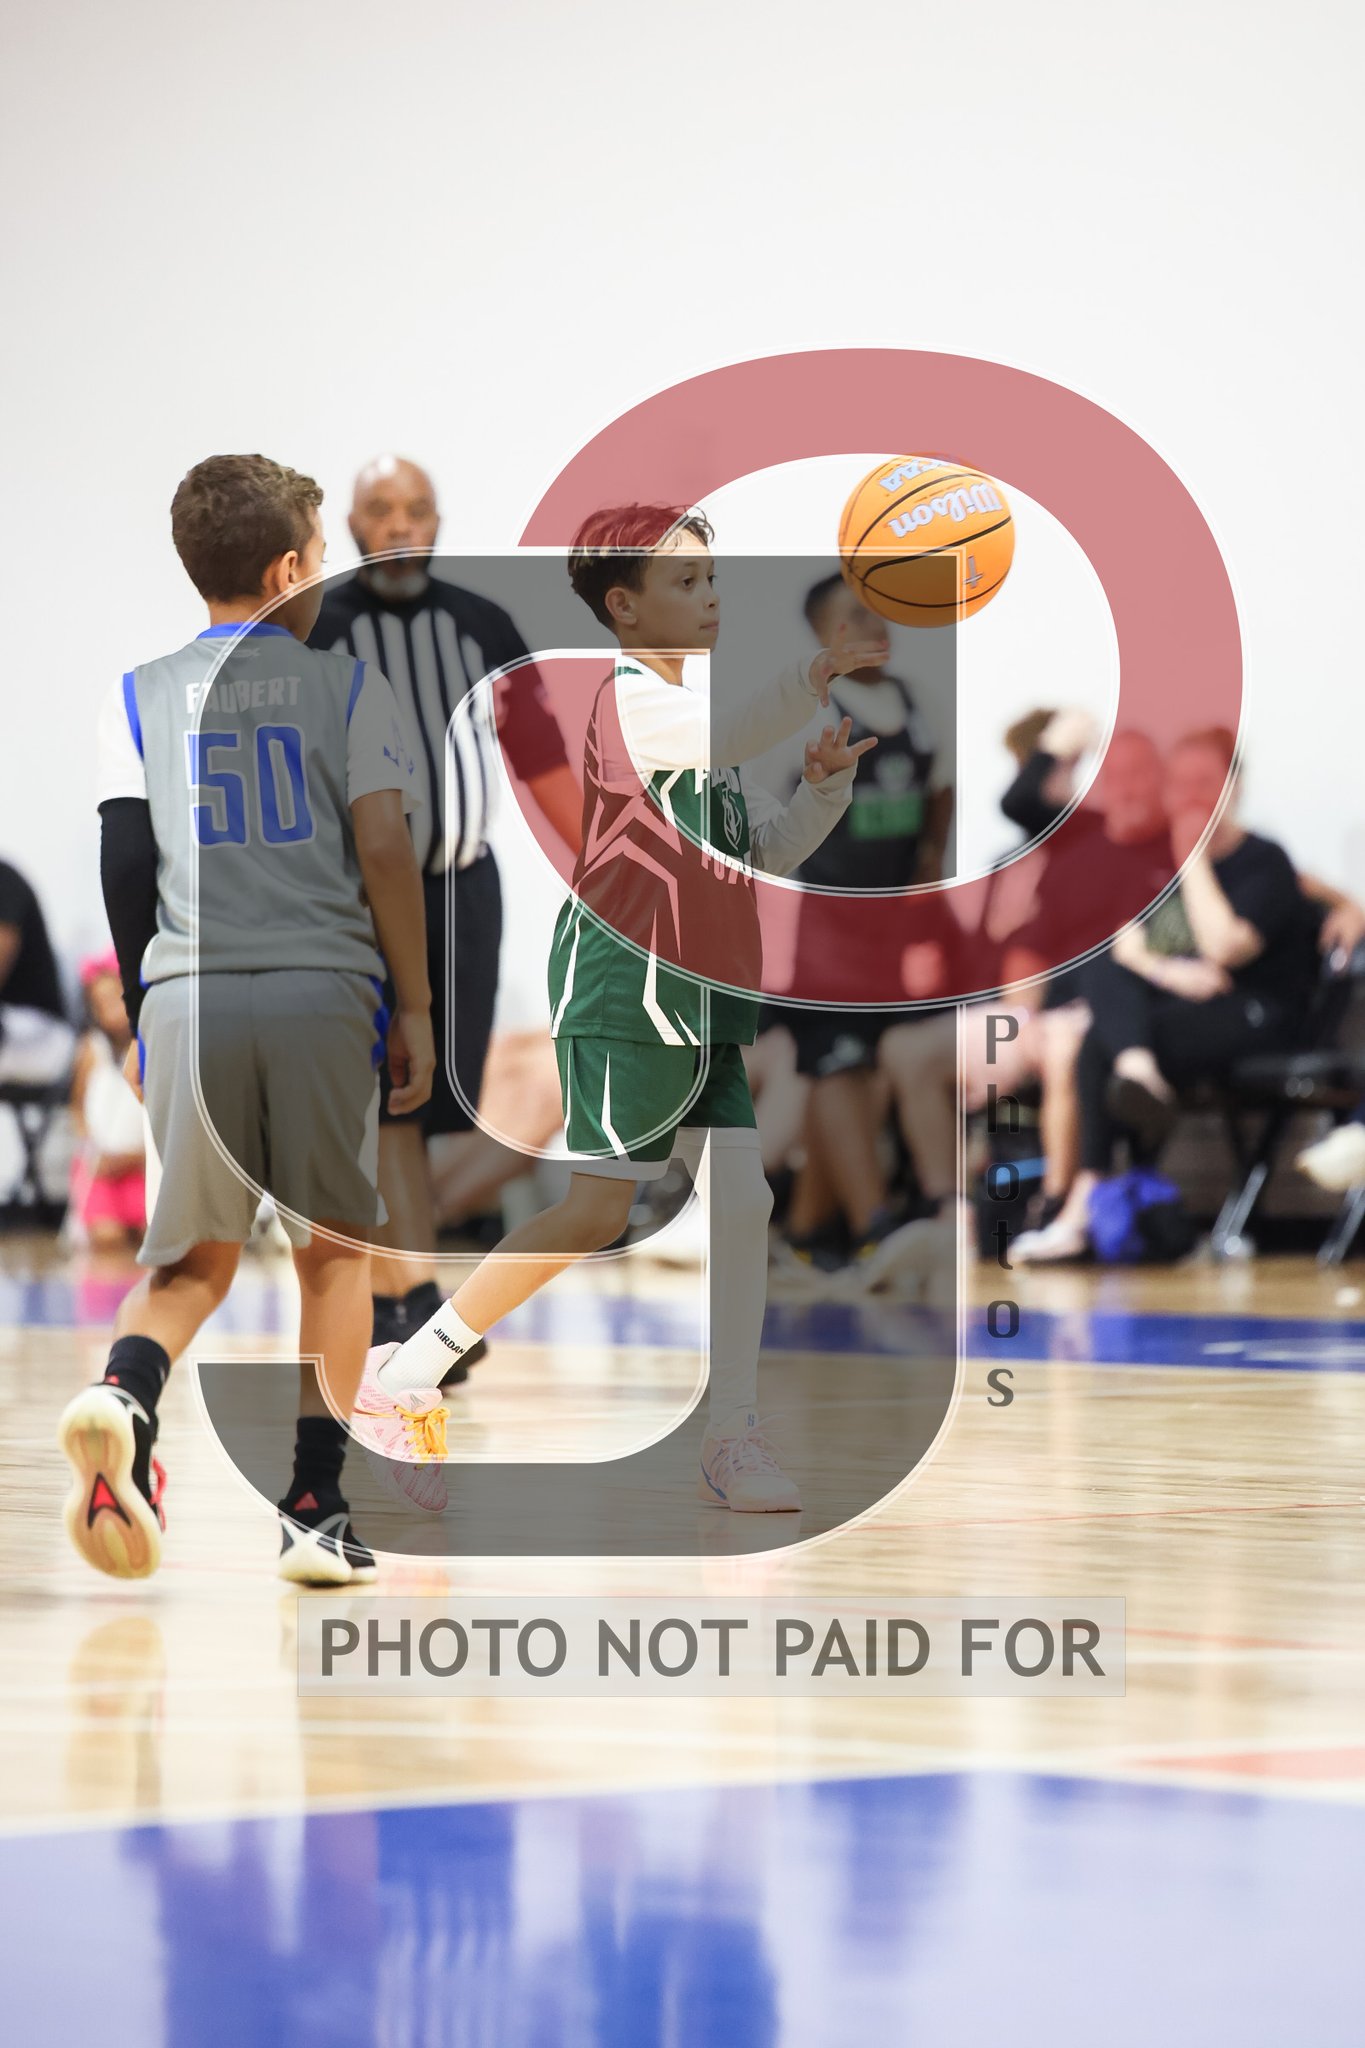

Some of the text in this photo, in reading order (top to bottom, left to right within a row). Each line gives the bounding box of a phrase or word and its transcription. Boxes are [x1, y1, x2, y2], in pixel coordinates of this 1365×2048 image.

[887, 482, 1004, 538] Wilson
[185, 675, 302, 714] FAUBERT
[183, 722, 317, 849] 50
[433, 1327, 466, 1355] JORDAN
